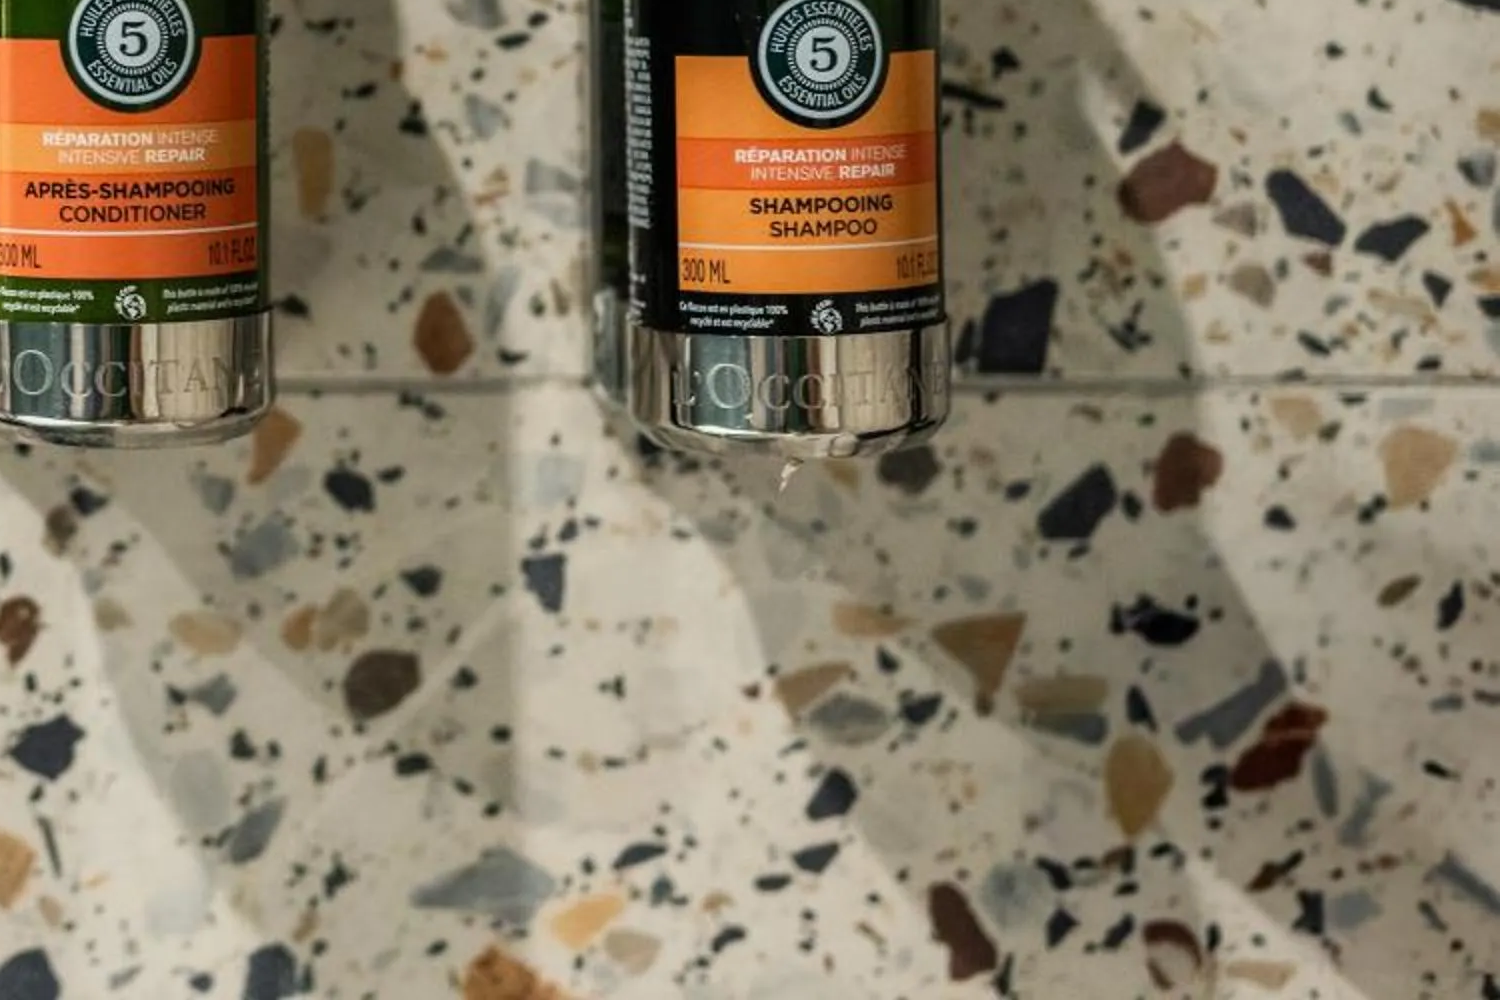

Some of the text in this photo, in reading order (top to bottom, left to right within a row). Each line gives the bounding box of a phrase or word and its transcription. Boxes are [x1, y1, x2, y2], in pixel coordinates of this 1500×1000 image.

[771, 1, 873, 53] HUILES ESSENTIELLES
[119, 20, 148, 57] 5
[810, 36, 838, 72] 5
[86, 57, 178, 92] ESSENTIAL OILS
[777, 73, 868, 108] ESSENTIAL OILS
[42, 127, 219, 147] RÉPARATION INTENSE
[57, 147, 206, 165] INTENSIVE REPAIR
[734, 144, 907, 164] RÉPARATION INTENSE
[750, 163, 896, 182] INTENSIVE REPAIR
[24, 178, 235, 199] APRÈS-SHAMPOOING
[59, 204, 206, 223] CONDITIONER
[749, 194, 893, 216] SHAMPOOING
[769, 218, 877, 238] SHAMPOO
[21, 243, 42, 269] ML
[682, 257, 731, 285] 300 ML
